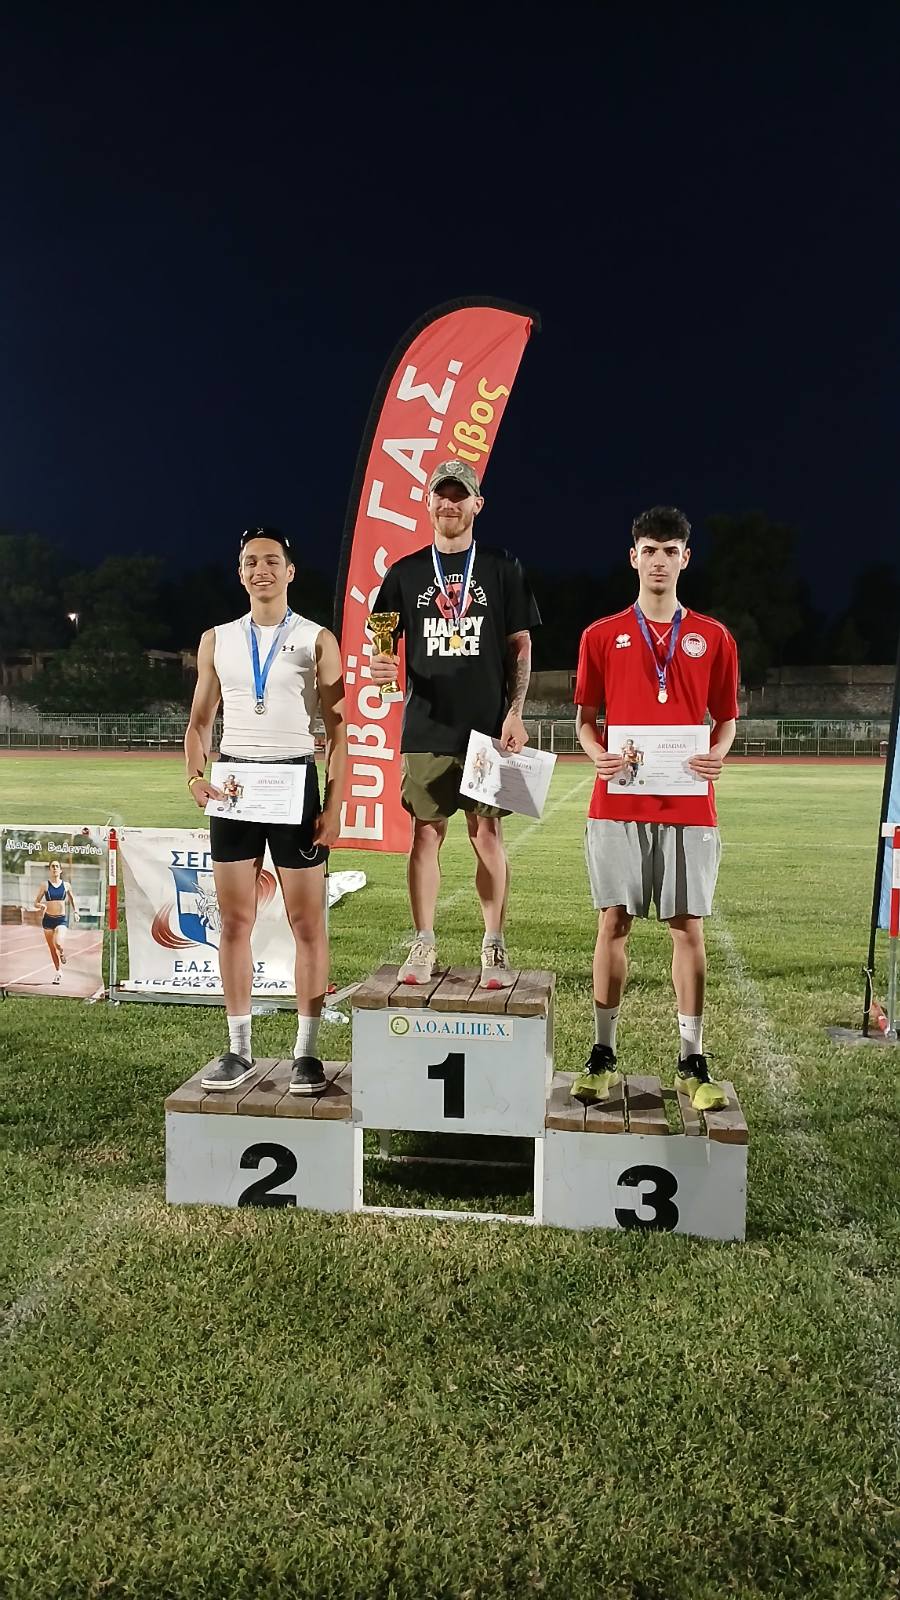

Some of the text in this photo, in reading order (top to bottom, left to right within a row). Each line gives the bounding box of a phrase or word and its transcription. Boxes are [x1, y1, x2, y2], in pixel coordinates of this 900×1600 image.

[417, 586, 436, 608] The
[473, 586, 488, 607] my
[423, 616, 484, 638] HAPPY
[427, 636, 480, 656] PLACE
[339, 545, 394, 841] Ευβοϊ
[174, 960, 215, 973] Ε.Α.Σ.
[427, 1052, 465, 1119] 1
[238, 1142, 297, 1208] 2
[614, 1164, 679, 1232] 3
